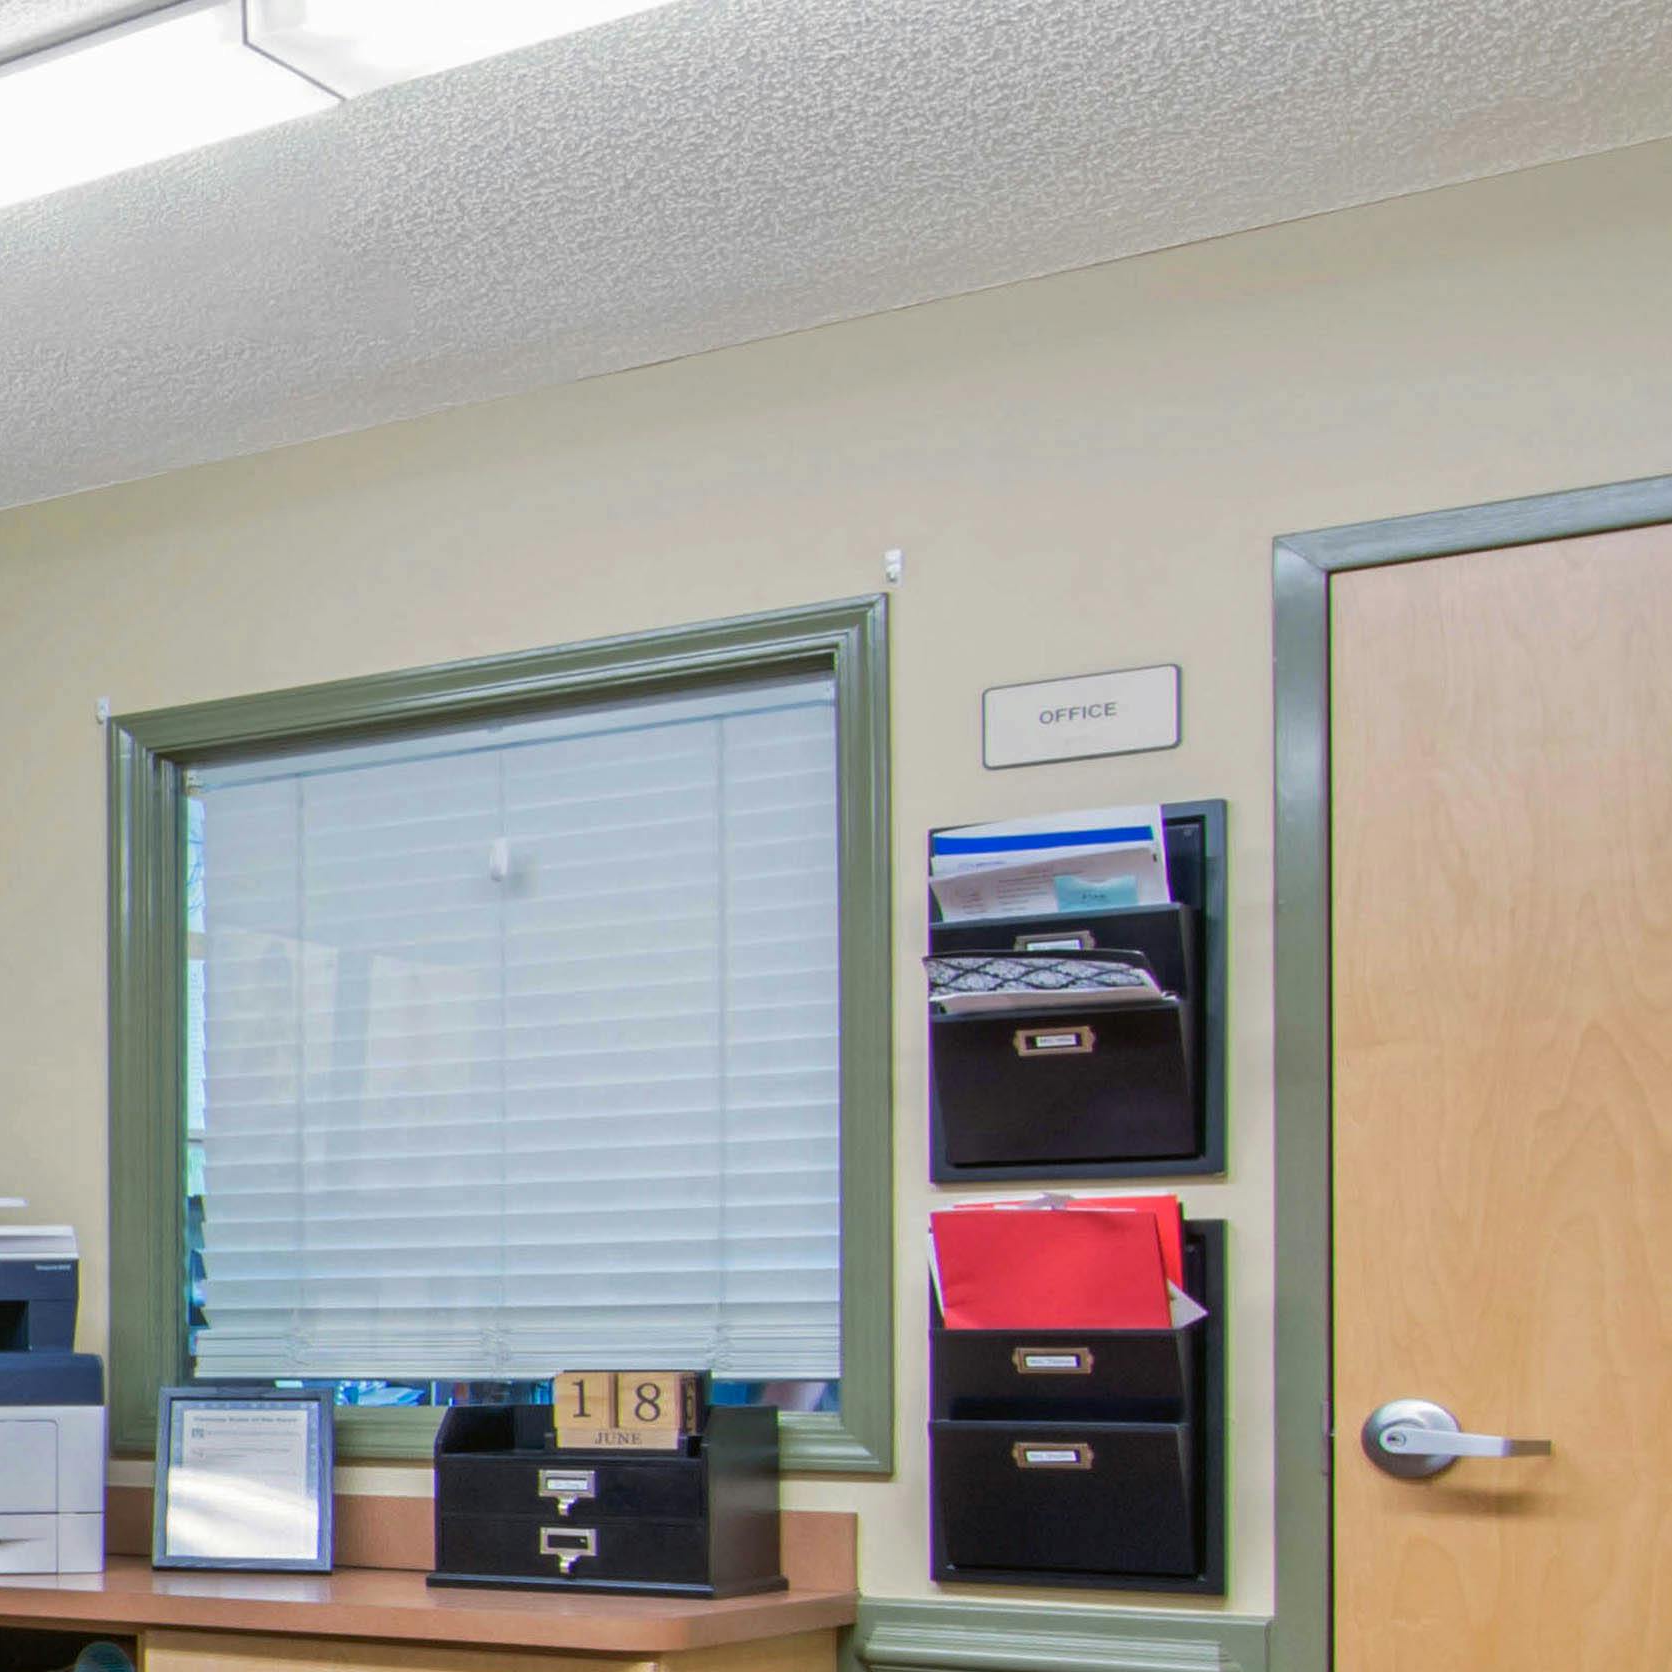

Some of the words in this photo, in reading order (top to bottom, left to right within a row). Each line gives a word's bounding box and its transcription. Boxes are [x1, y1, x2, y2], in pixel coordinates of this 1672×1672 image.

[1038, 701, 1119, 725] OFFICE
[572, 1379, 591, 1418] 1
[634, 1382, 661, 1422] 8
[595, 1432, 643, 1446] JUNE
